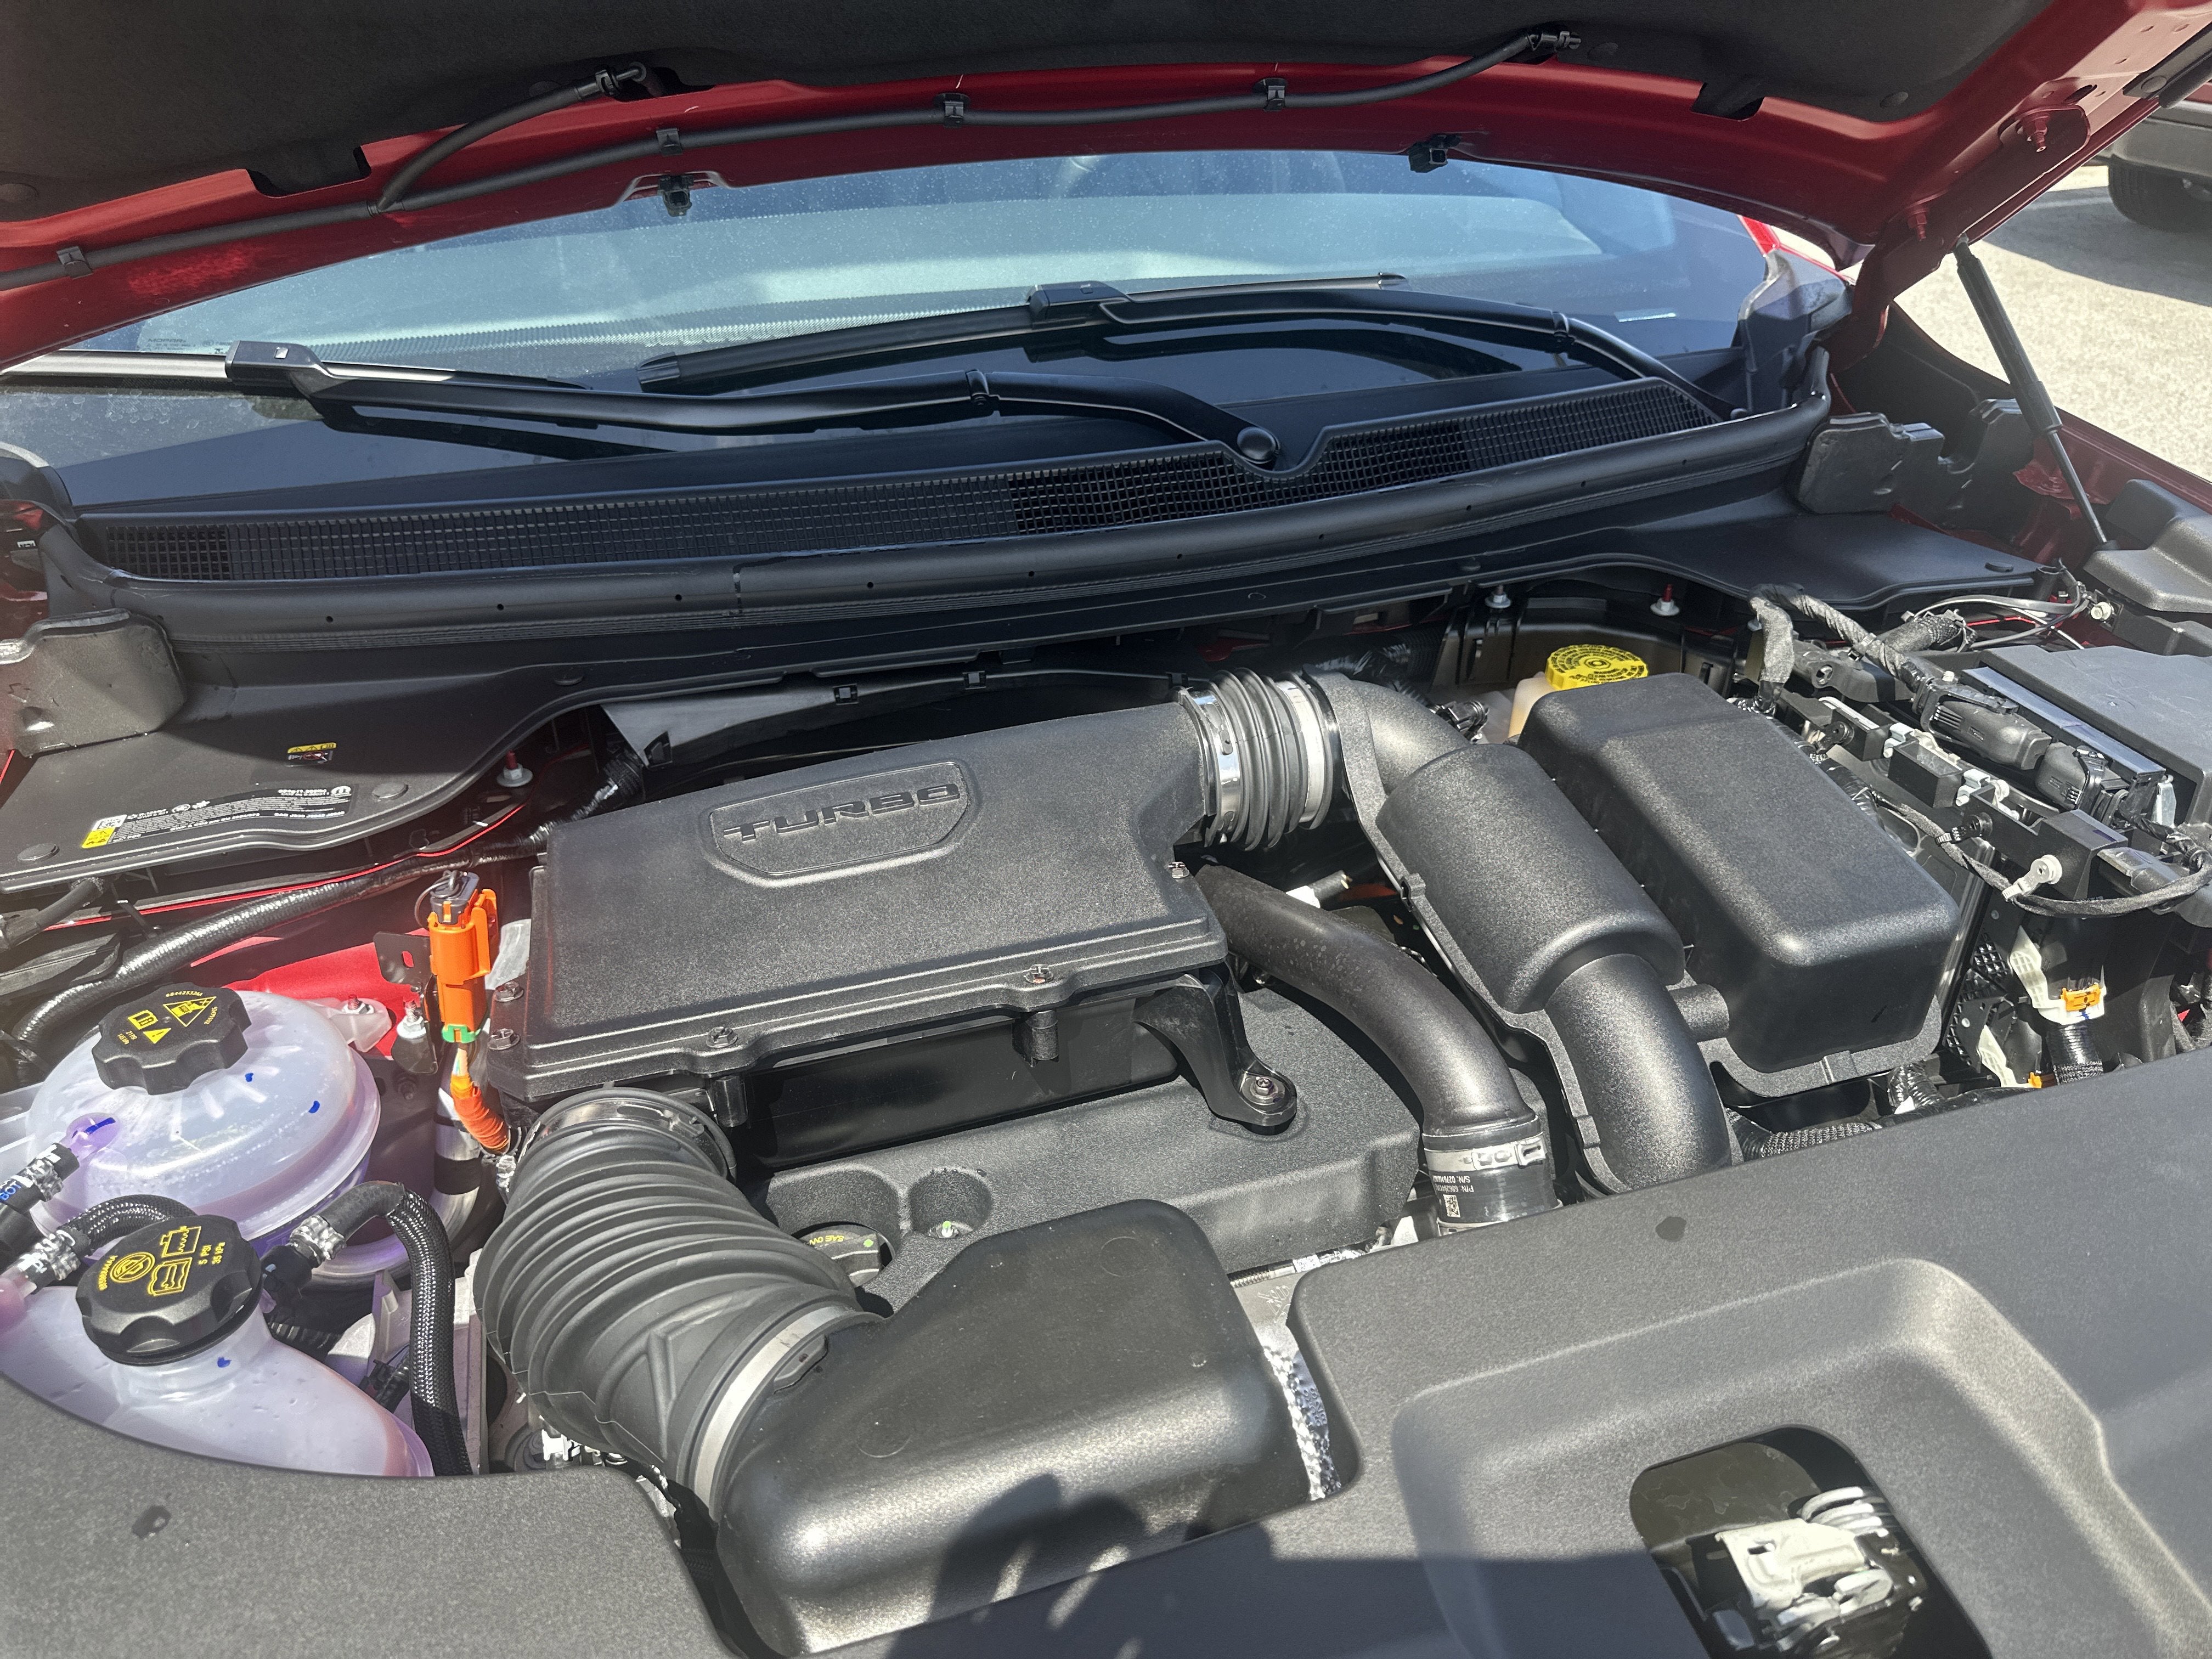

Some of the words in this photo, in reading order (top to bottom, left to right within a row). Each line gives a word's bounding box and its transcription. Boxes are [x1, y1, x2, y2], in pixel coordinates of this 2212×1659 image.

[724, 783, 960, 842] TURBO
[200, 1244, 212, 1257] PSI
[215, 1242, 226, 1255] kPa
[212, 1255, 223, 1265] 35
